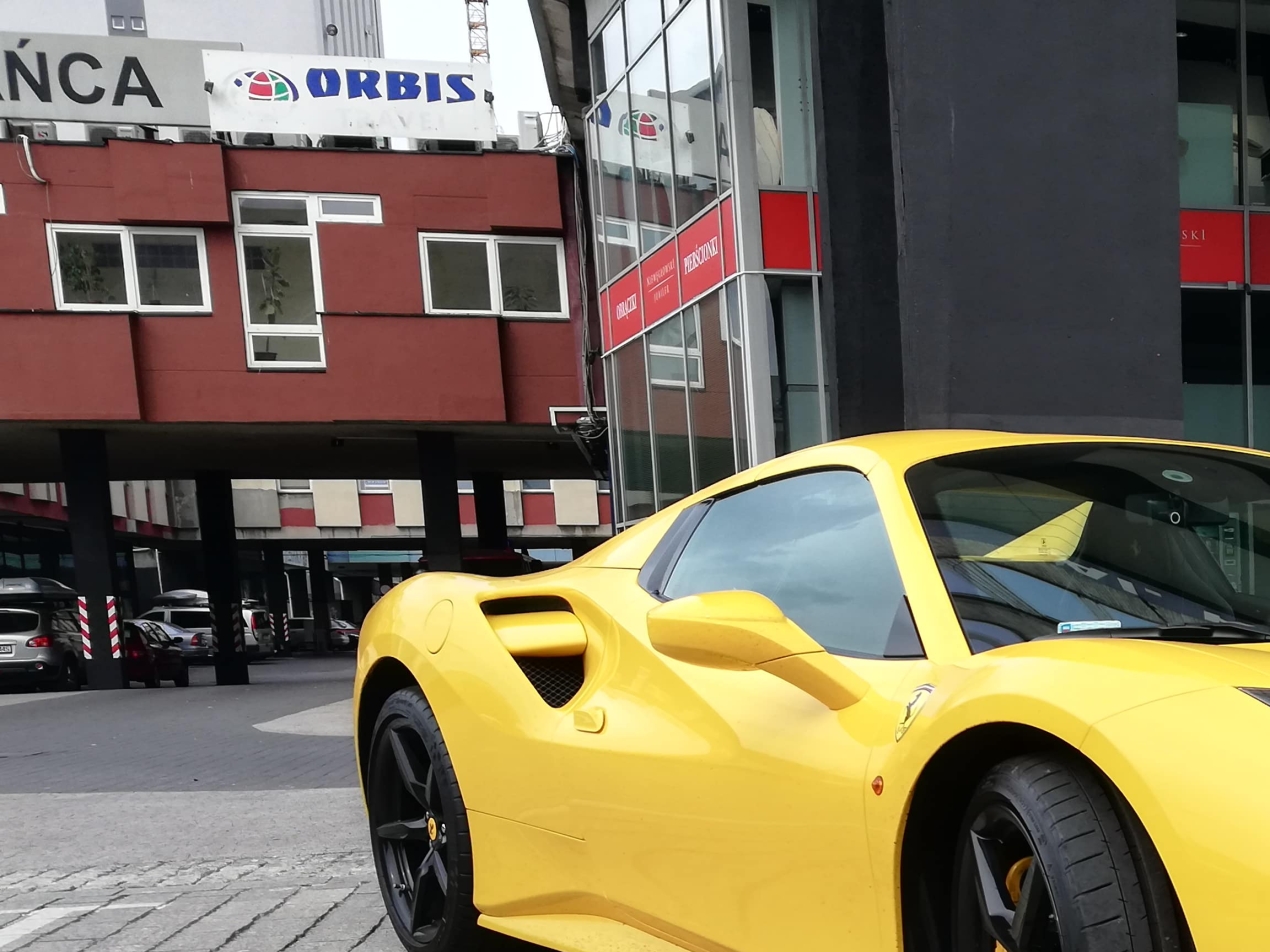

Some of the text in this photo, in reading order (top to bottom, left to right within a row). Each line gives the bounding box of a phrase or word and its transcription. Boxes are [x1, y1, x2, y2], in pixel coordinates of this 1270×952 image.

[0, 40, 163, 108] ŃCA
[305, 67, 477, 103] ORBIS
[683, 235, 718, 276] PIERŚCIONKI
[616, 293, 637, 320] OBRĄCZKI
